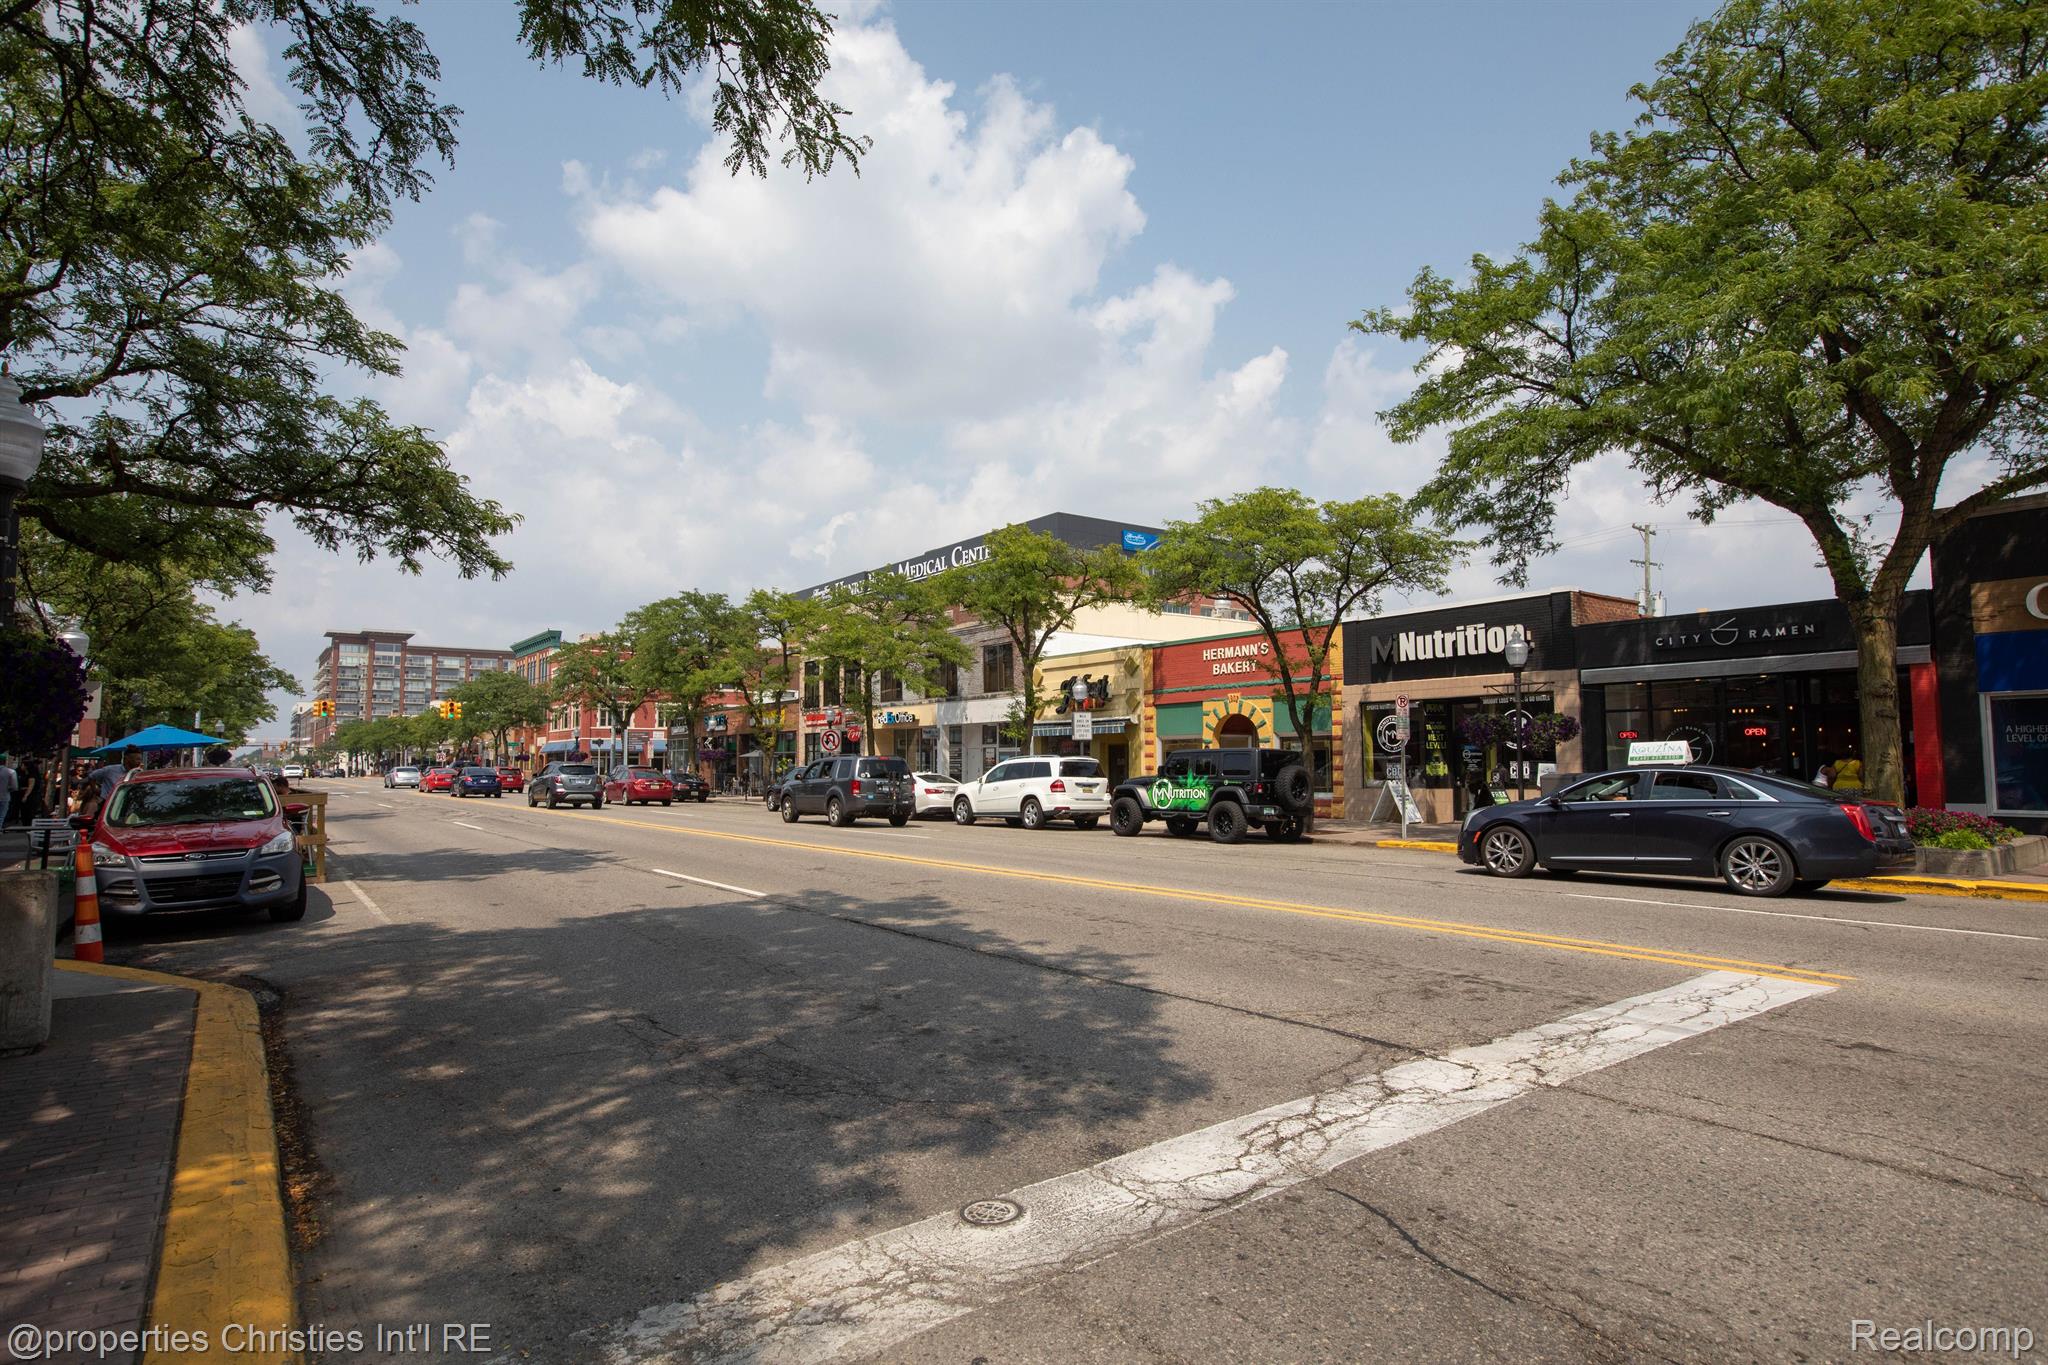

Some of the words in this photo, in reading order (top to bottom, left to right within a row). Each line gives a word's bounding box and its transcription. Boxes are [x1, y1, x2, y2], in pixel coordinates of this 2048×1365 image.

[898, 556, 947, 578] MEDICAL
[1655, 634, 1700, 646] CITY
[1749, 624, 1815, 639] RAMEN
[1203, 642, 1269, 661] HERMANN'S
[895, 713, 914, 724] Office
[1744, 727, 1767, 736] OPEN
[2005, 725, 2013, 733] A
[1619, 731, 1638, 739] OPEN
[2006, 734, 2034, 743] LEVEL
